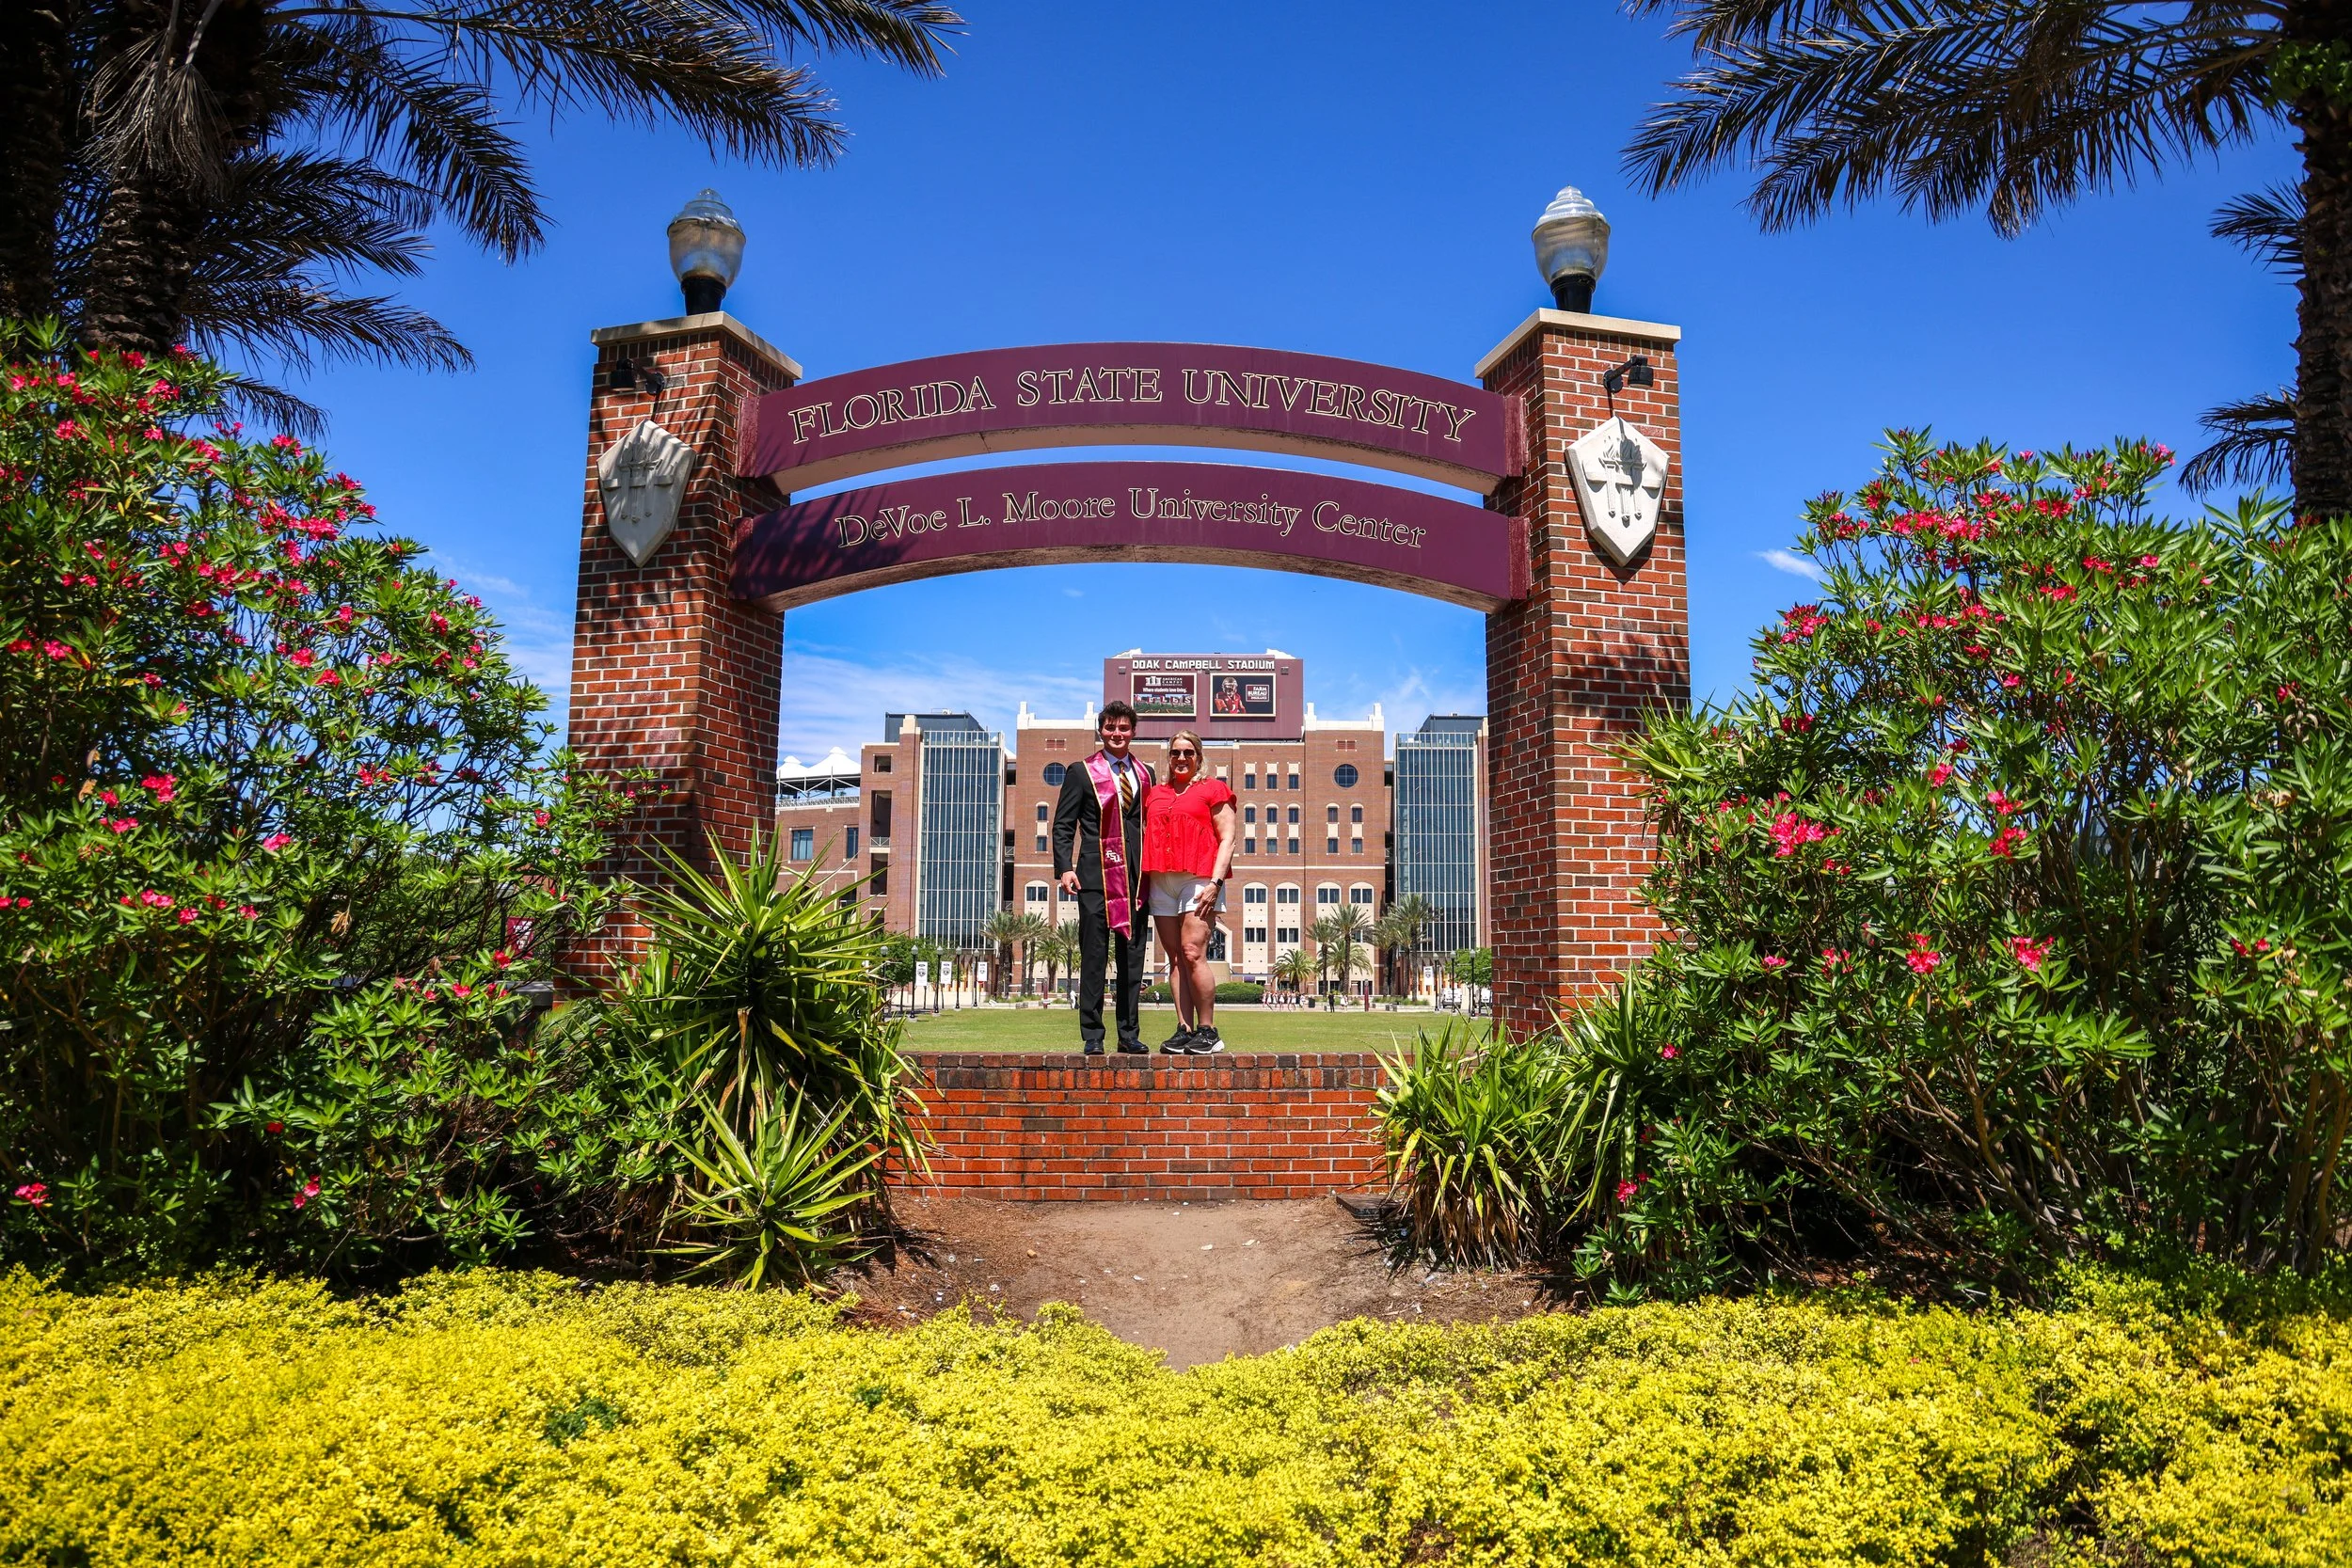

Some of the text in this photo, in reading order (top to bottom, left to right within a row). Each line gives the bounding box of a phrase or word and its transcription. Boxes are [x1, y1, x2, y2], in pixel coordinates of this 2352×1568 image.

[788, 366, 1477, 445] FLORIDA STATE UNIVERSITY
[834, 487, 1427, 549] DeVoe L. Moore University Center
[1132, 659, 1275, 671] DOAK CAMPBELL STADIUM
